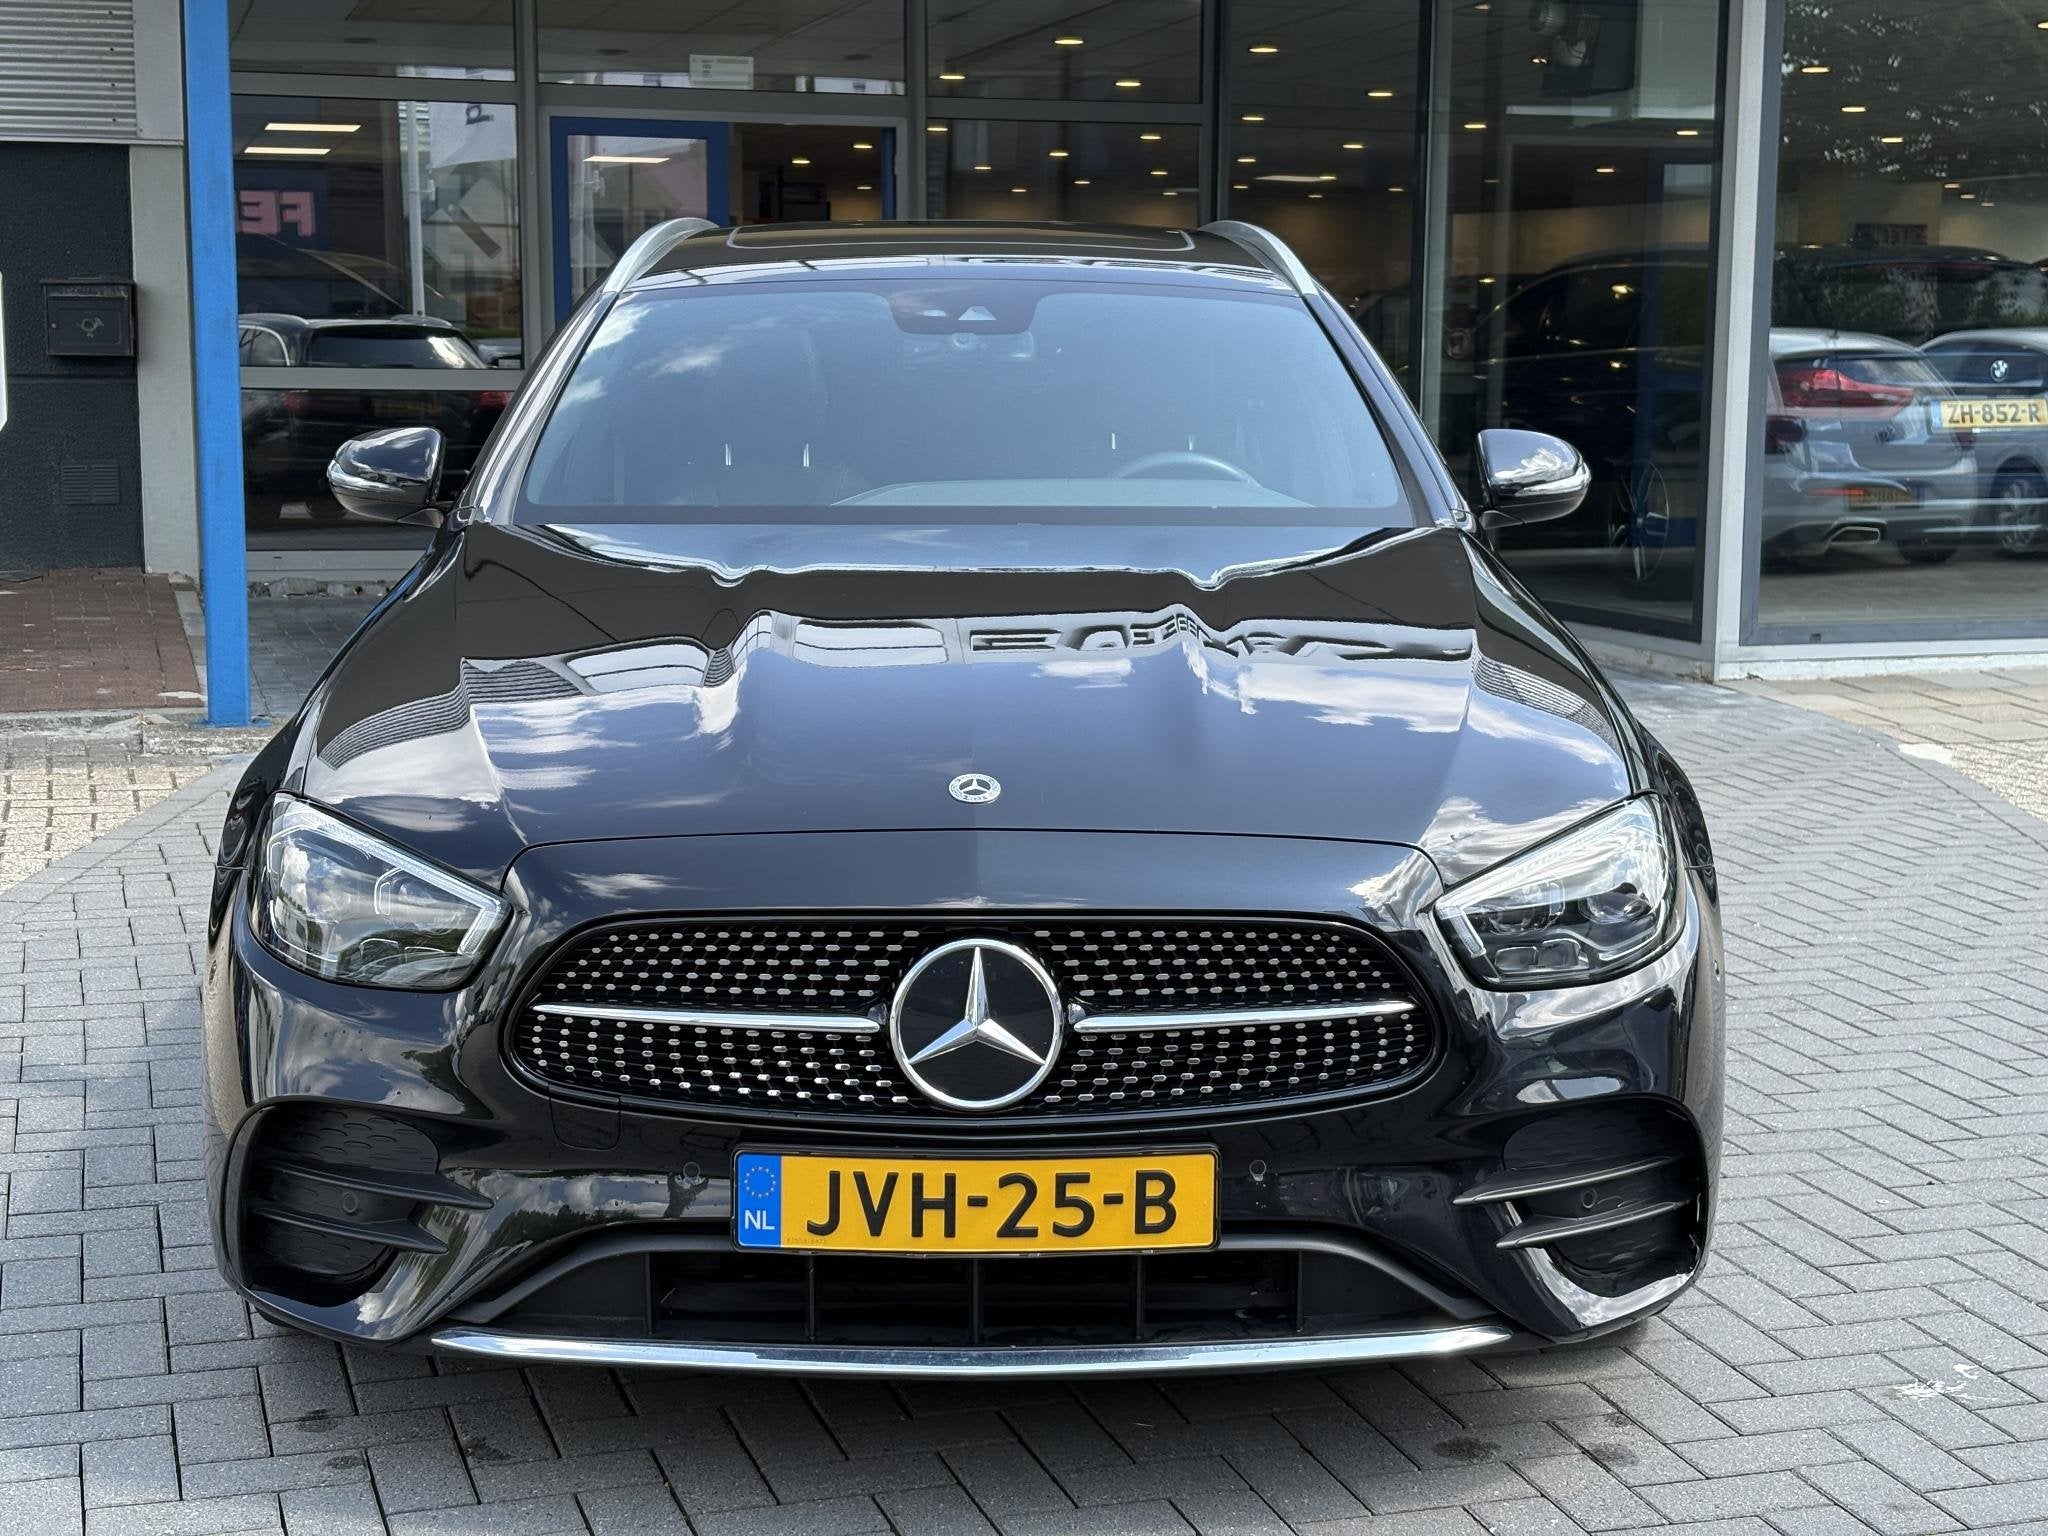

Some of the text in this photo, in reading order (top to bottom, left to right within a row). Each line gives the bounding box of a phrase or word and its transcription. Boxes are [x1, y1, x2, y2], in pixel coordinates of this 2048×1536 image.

[1947, 403, 2041, 424] ZH-852-R
[806, 1169, 1178, 1238] JVH-25-B
[744, 1209, 775, 1231] NL
